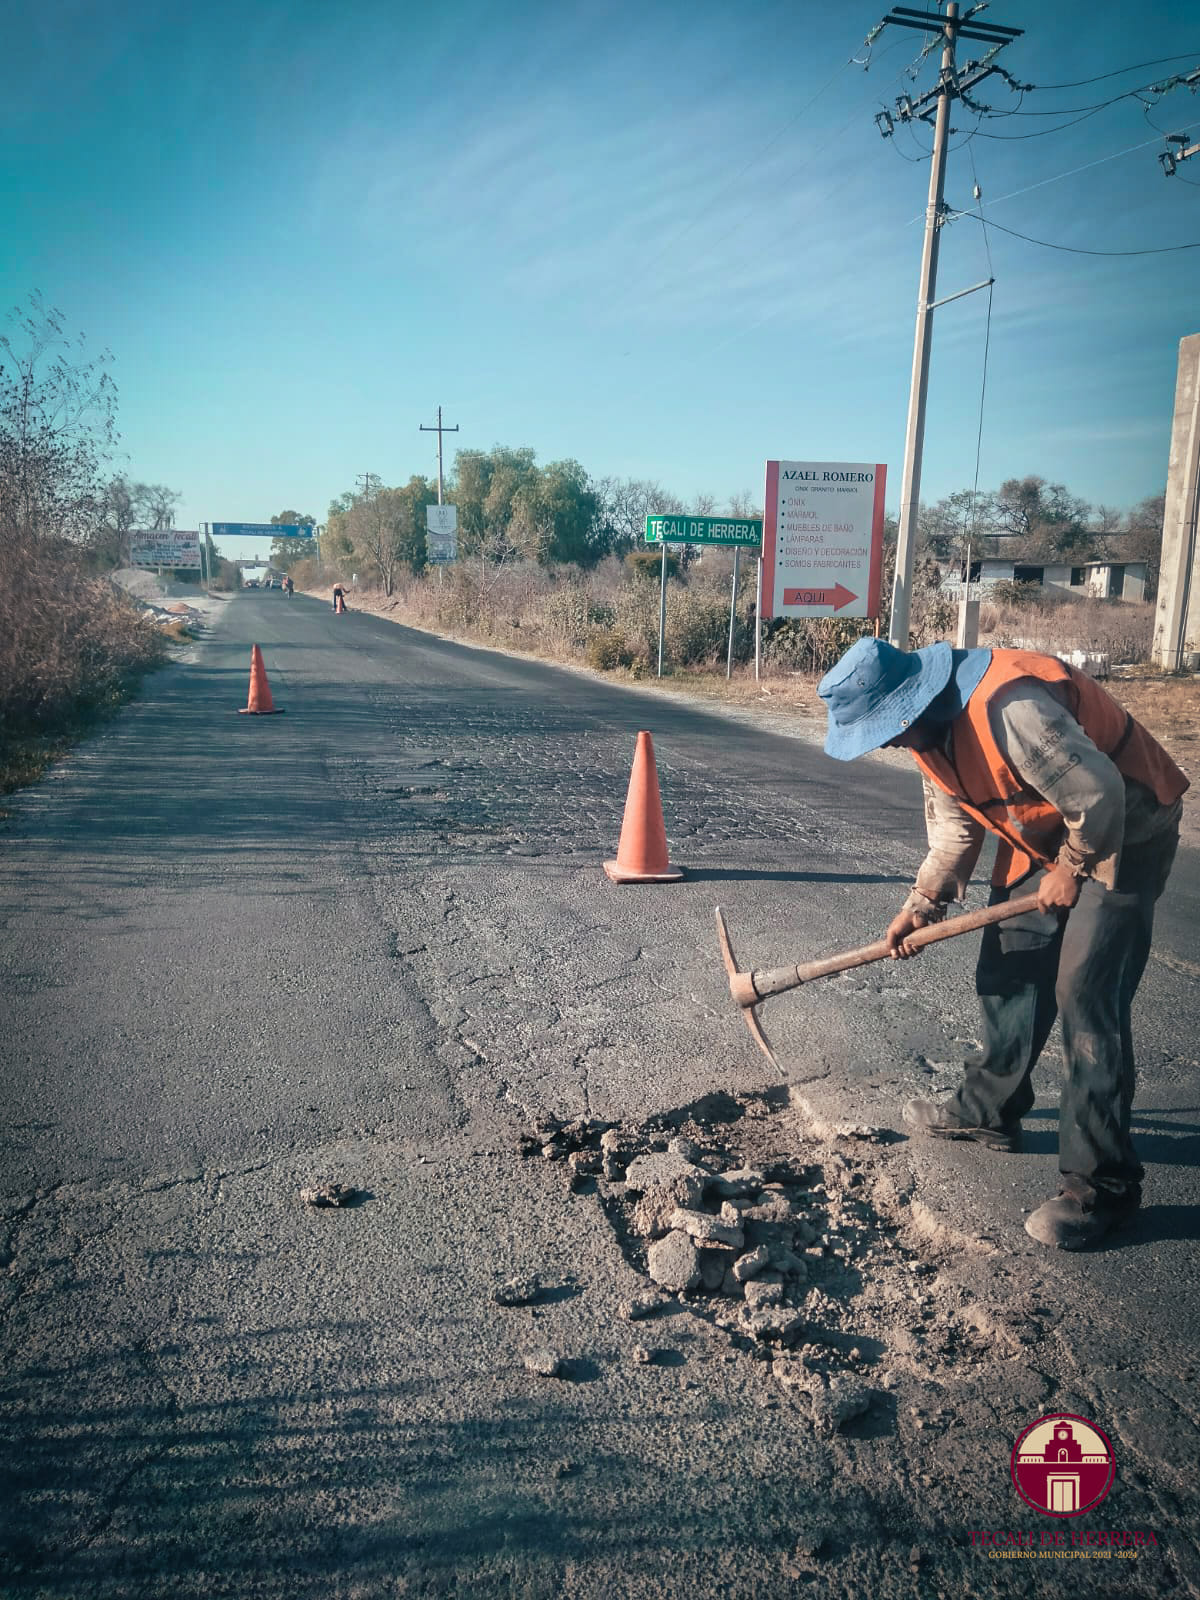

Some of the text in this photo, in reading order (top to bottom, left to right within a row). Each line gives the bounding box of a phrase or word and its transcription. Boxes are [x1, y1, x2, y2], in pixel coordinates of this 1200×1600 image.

[782, 470, 874, 483] AZAEL ROMERO
[650, 520, 757, 540] TECALI DE HERRERA
[787, 523, 821, 532] MUEBLES
[822, 523, 833, 532] DE
[814, 547, 820, 556] Y
[784, 559, 861, 569] SOMOS FABRICANTES
